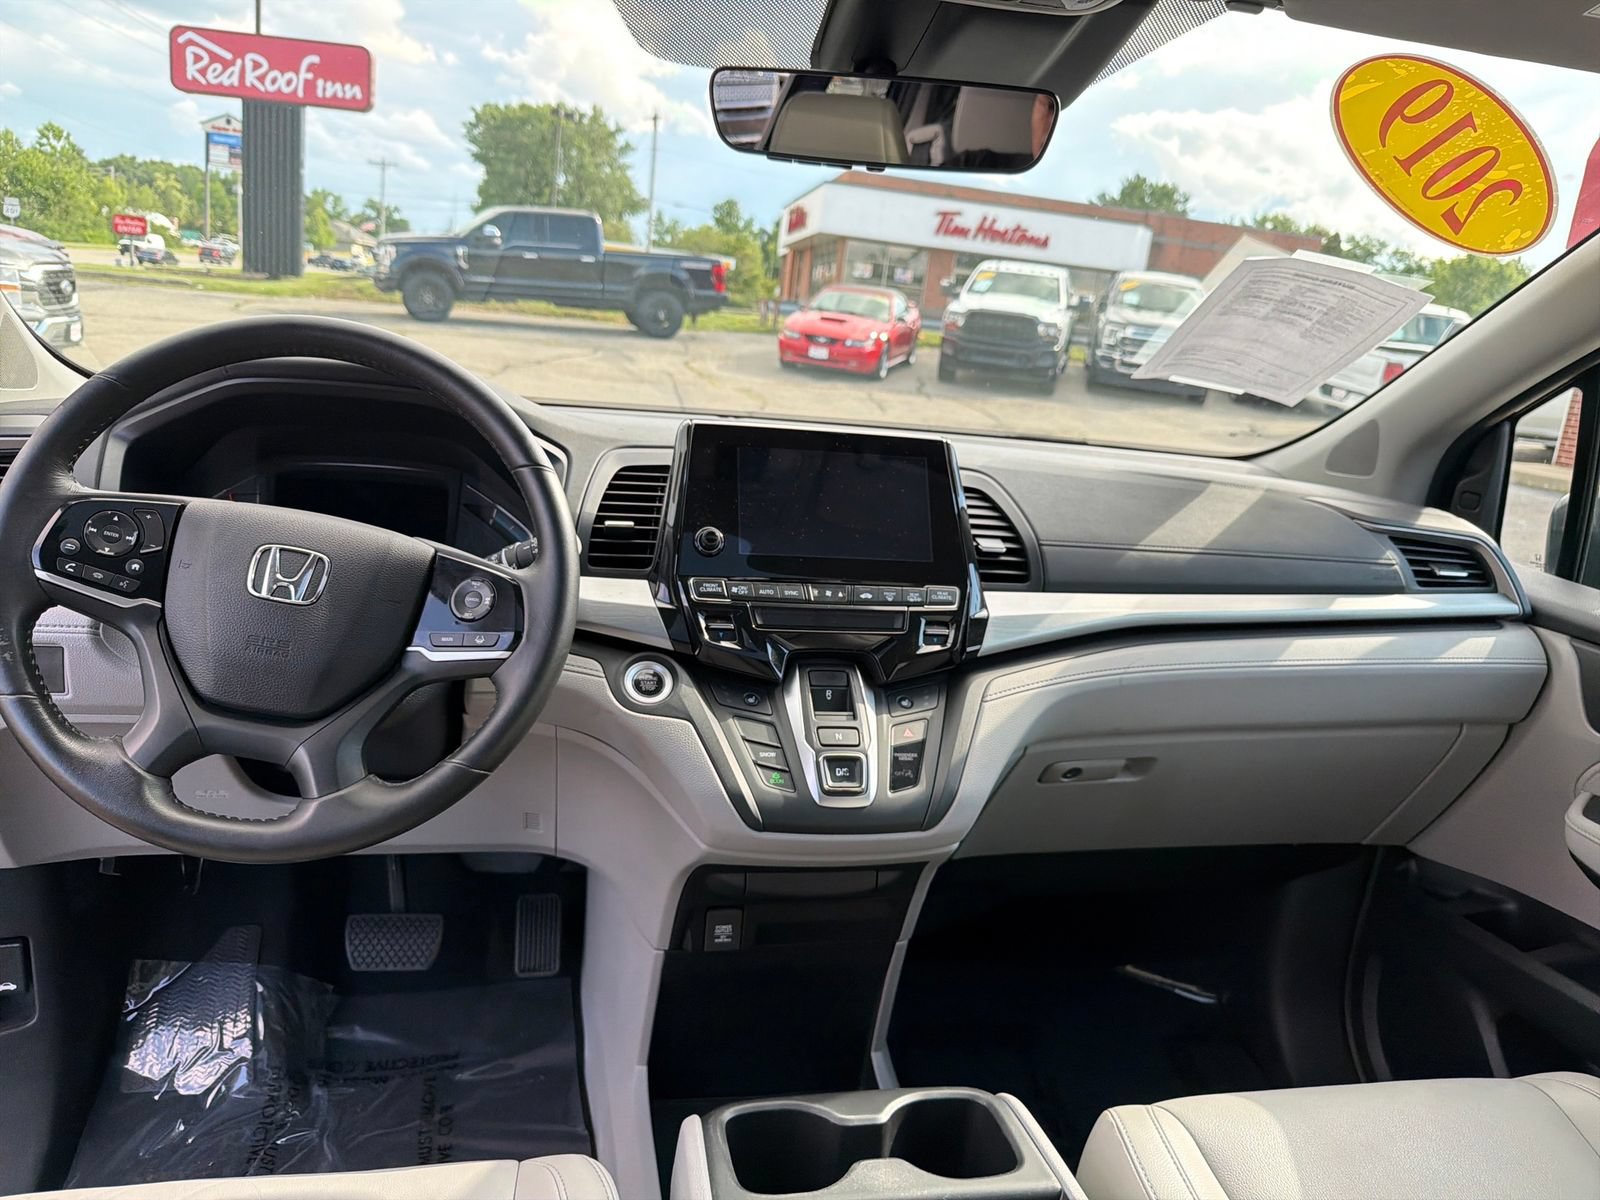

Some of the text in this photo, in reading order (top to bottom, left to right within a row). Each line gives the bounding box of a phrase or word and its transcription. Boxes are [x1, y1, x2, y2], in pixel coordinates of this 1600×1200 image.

[185, 45, 242, 87] Red
[244, 52, 321, 98] Roof
[934, 211, 1050, 248] Tim Hortons
[103, 530, 120, 538] ENTER
[835, 732, 843, 740] N
